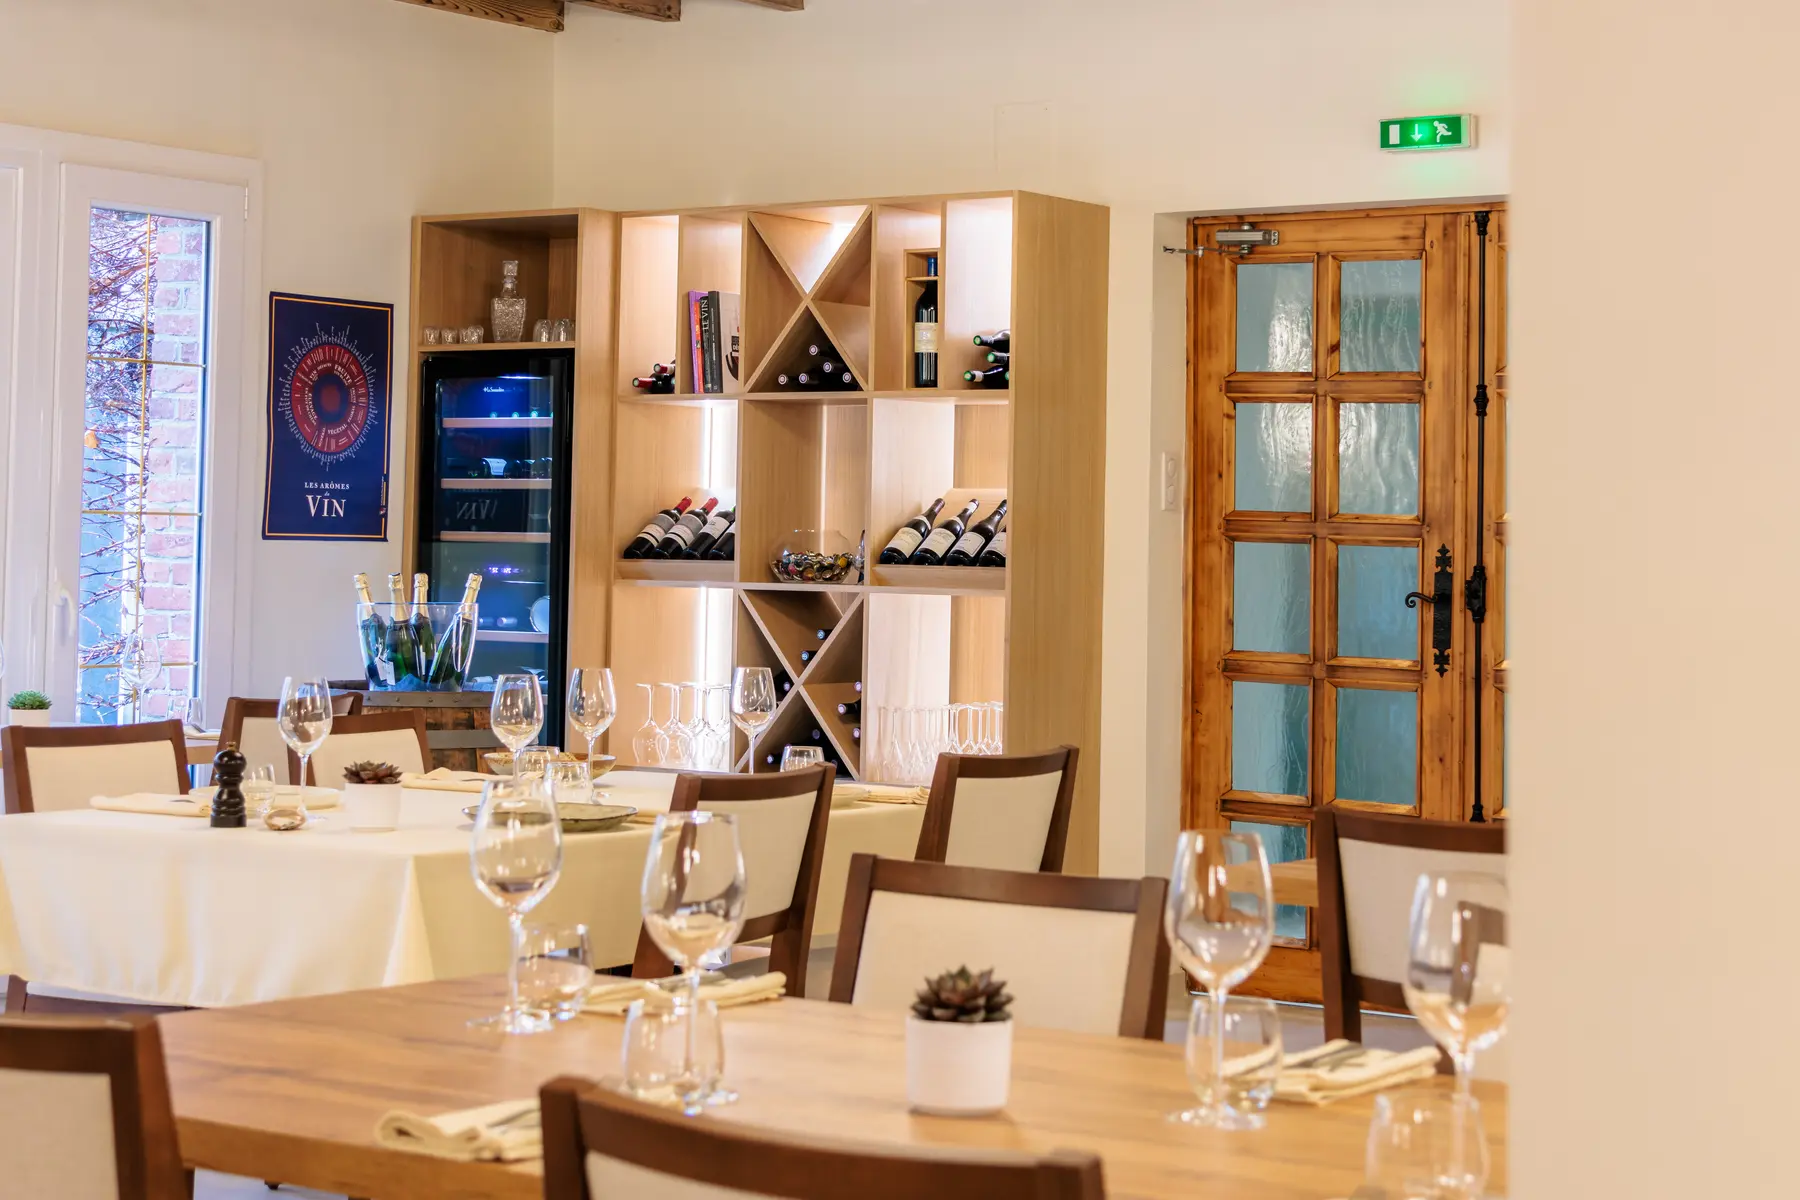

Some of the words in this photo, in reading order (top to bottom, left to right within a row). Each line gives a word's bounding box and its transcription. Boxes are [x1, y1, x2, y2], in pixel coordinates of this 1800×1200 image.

[701, 300, 709, 319] VIN
[319, 480, 350, 490] ARÔMES
[306, 494, 347, 518] VIN
